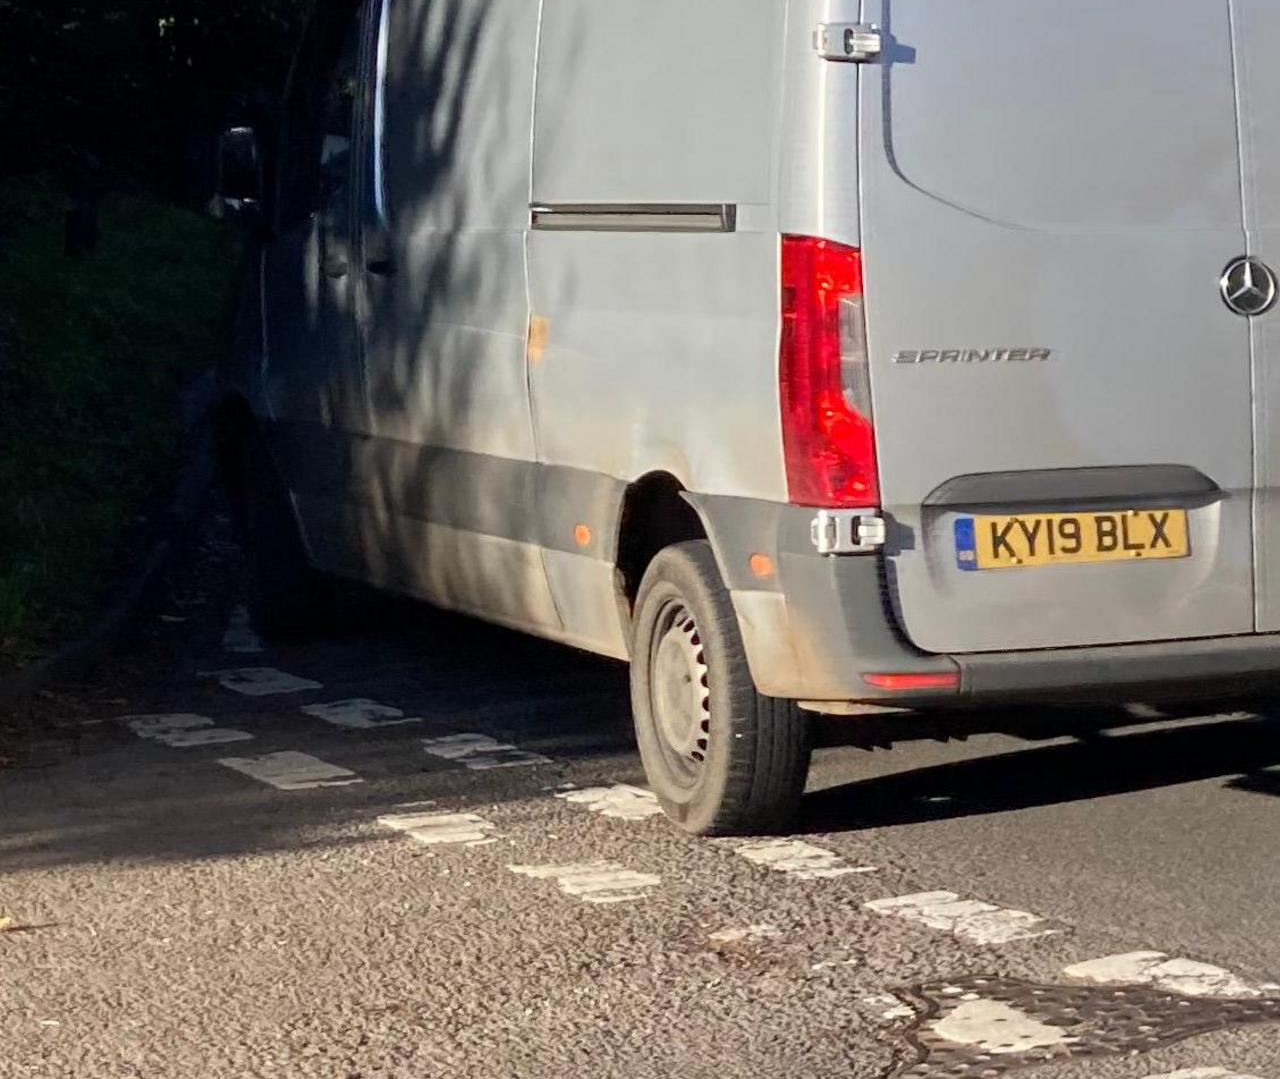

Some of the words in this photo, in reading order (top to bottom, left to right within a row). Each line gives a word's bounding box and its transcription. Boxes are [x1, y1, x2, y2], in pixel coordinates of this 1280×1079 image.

[891, 347, 1051, 364] SPRINTER
[990, 518, 1082, 559] KY19
[1094, 512, 1172, 552] BLX
